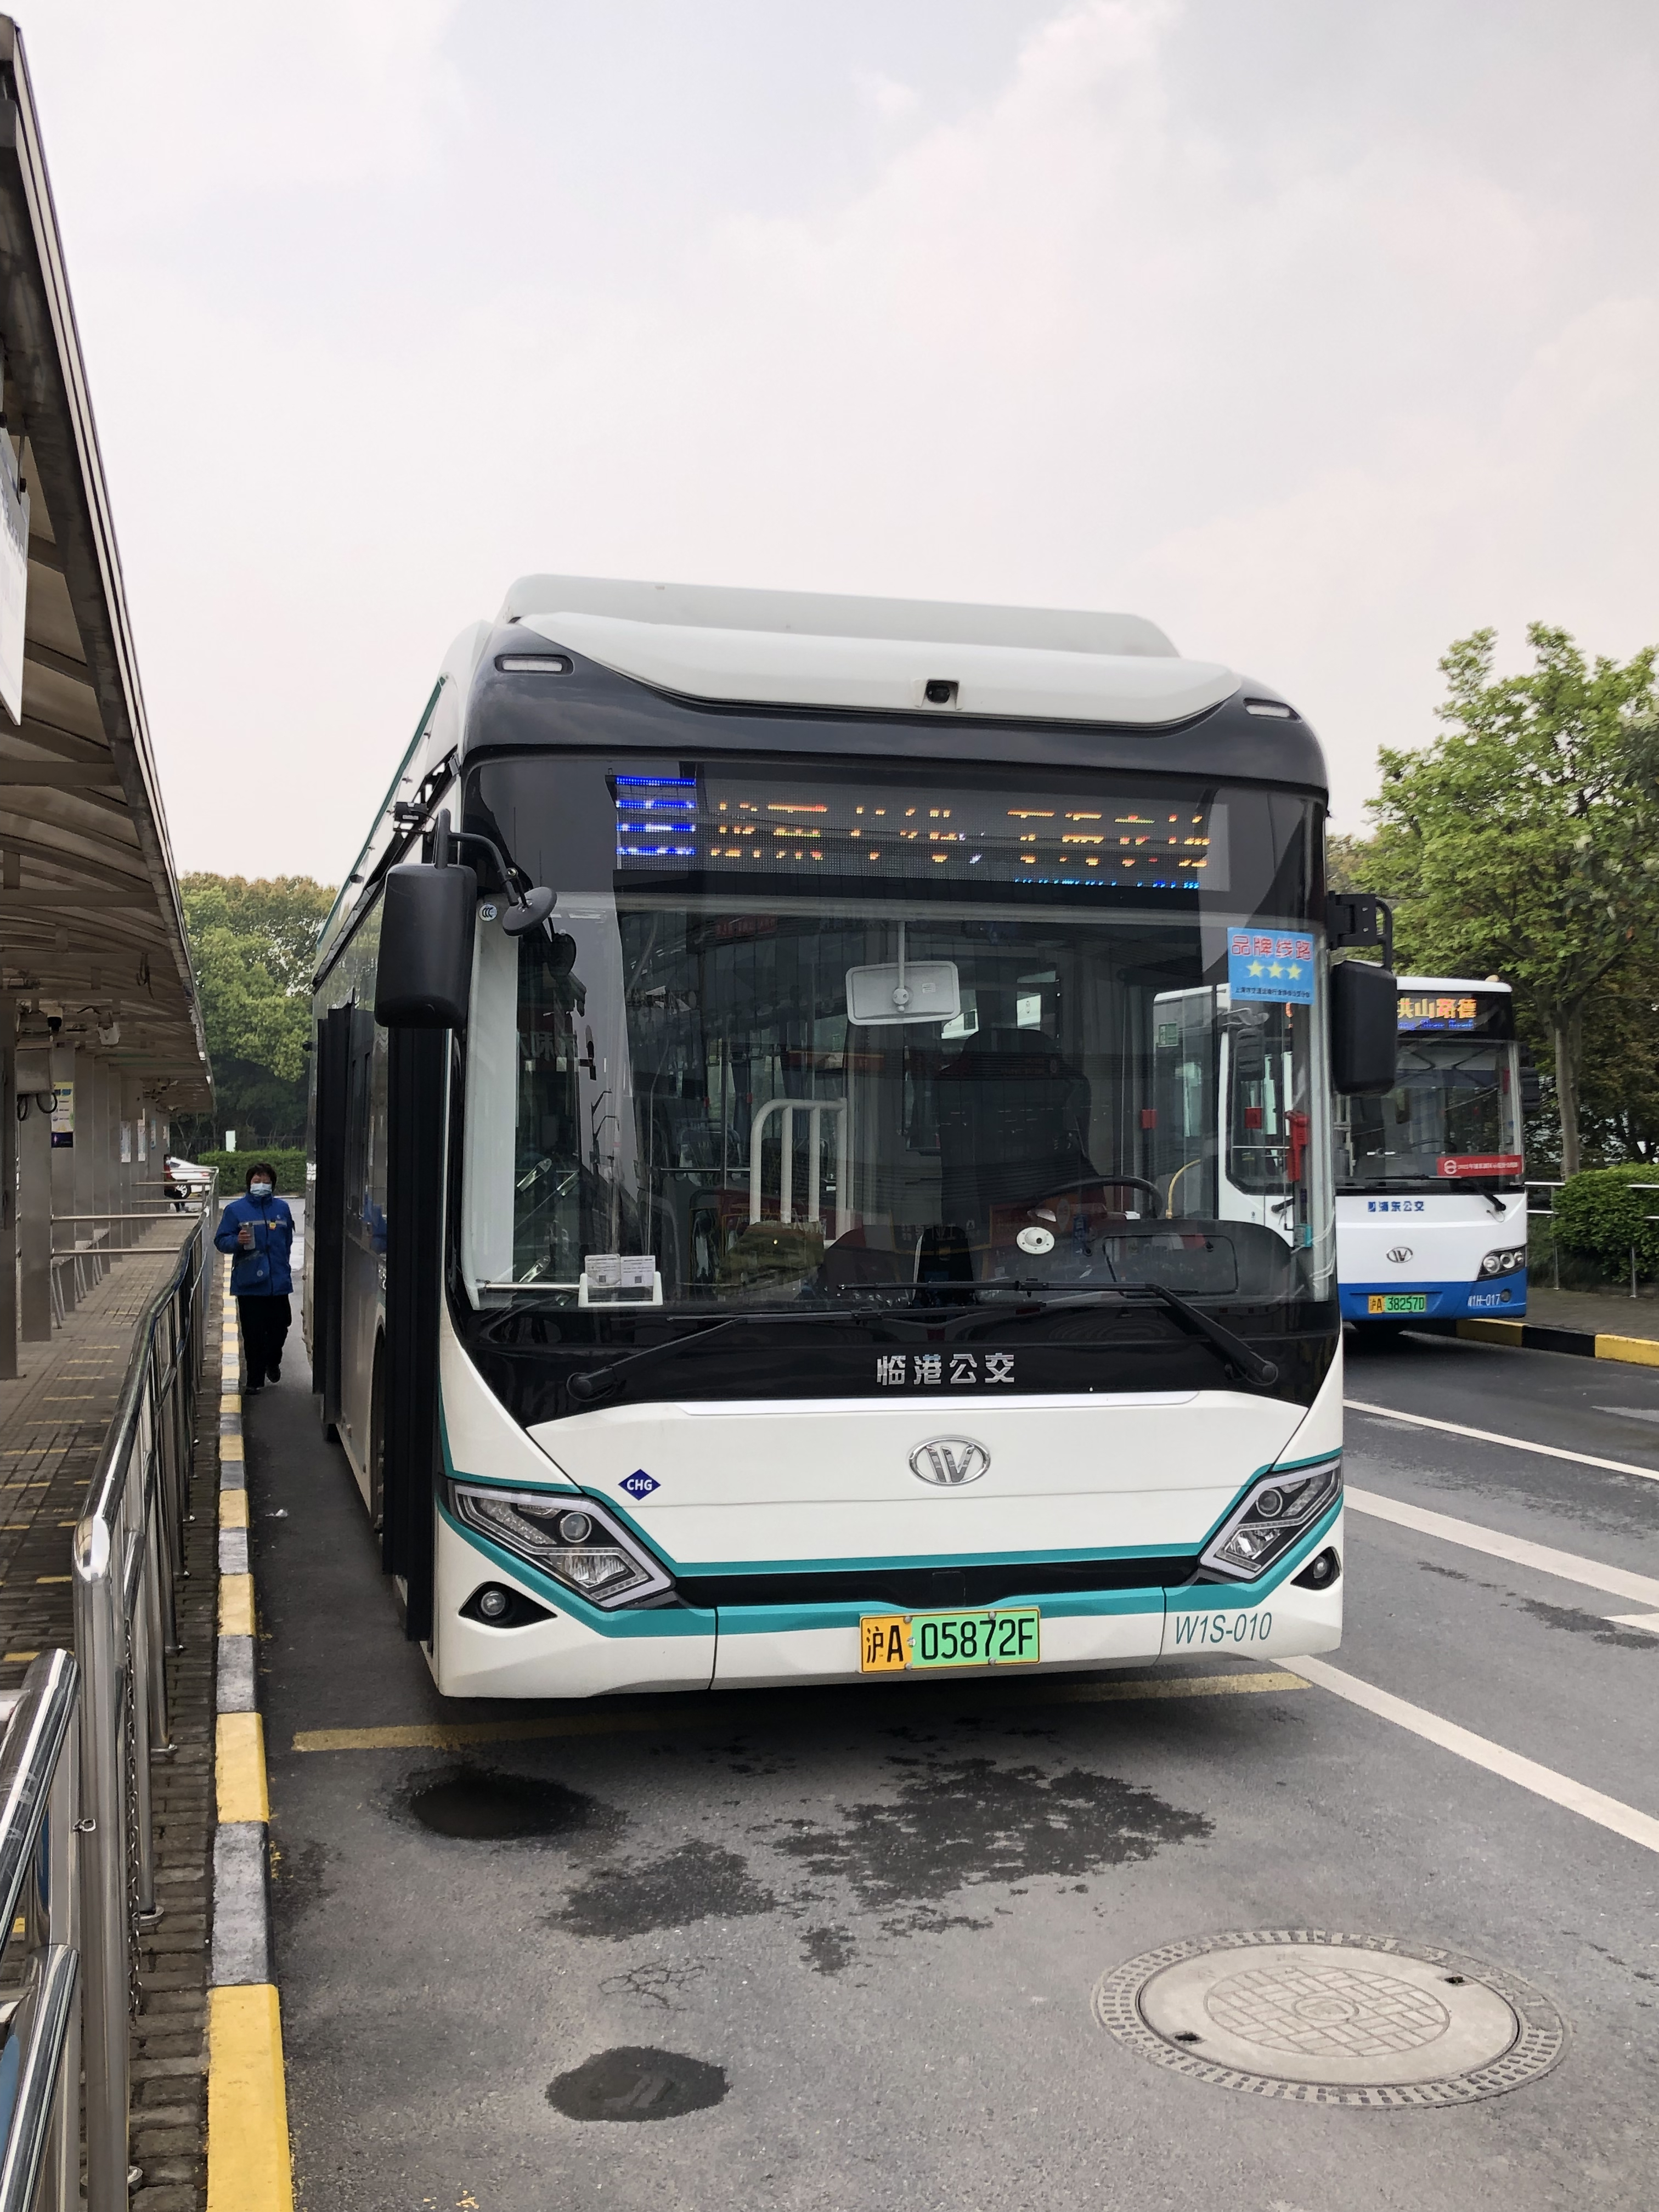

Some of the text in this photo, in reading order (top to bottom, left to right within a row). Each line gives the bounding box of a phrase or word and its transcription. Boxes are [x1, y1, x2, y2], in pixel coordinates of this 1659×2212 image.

[1232, 934, 1313, 961] 品牌线路
[1387, 1296, 1425, 1311] 38257D
[877, 1353, 1014, 1386] 临港公交
[627, 1479, 652, 1491] CHG
[921, 1618, 1035, 1660] 05872F
[1176, 1612, 1272, 1644] W1S-010
